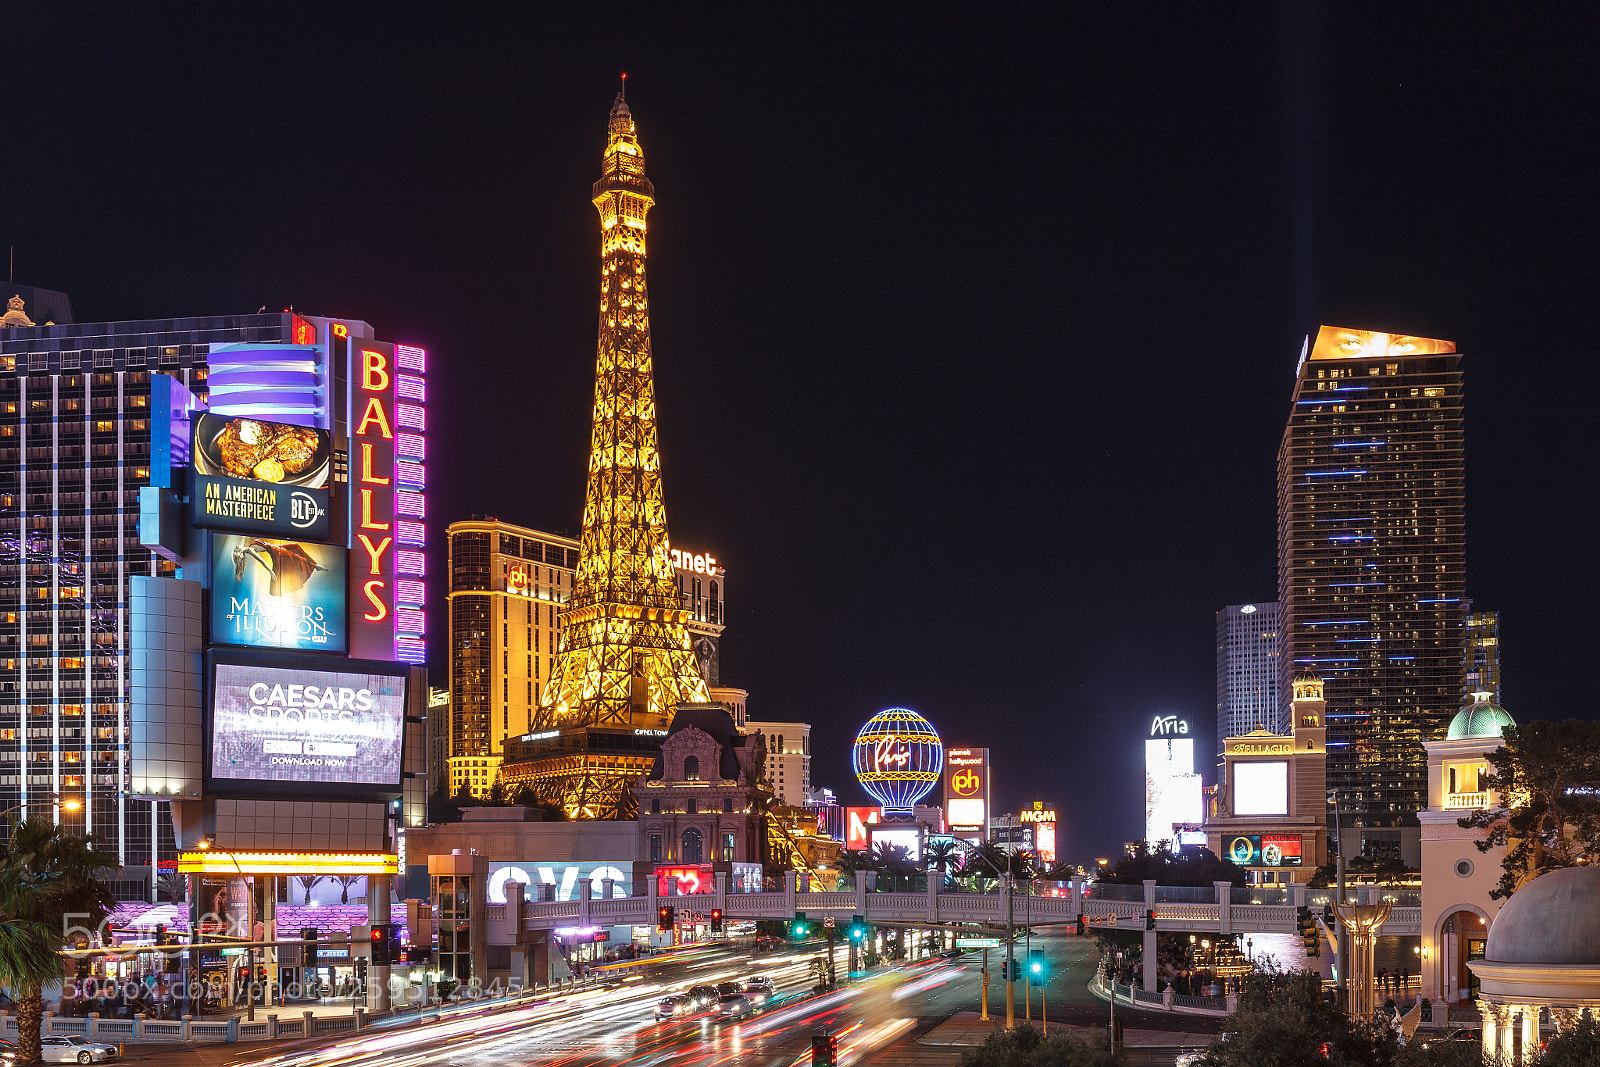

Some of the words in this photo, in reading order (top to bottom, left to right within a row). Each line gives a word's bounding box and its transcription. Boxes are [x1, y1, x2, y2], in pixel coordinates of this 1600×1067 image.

[205, 482, 220, 499] AN
[225, 484, 276, 505] AMERICAN
[356, 350, 393, 621] BALLYS
[206, 498, 275, 521] MASTERPIECE
[291, 499, 311, 520] BLT
[511, 566, 527, 586] ph
[249, 682, 373, 711] CAESARS
[1151, 716, 1187, 736] Aria
[874, 735, 911, 776] Paris
[949, 749, 971, 758] planet
[1233, 744, 1292, 754] BELLAGIO
[271, 757, 323, 768] DOWNLOAD
[325, 759, 347, 768] NOW
[949, 758, 982, 766] hollywood
[955, 769, 979, 792] ph
[1020, 810, 1056, 822] MGM
[489, 866, 627, 903] CVS
